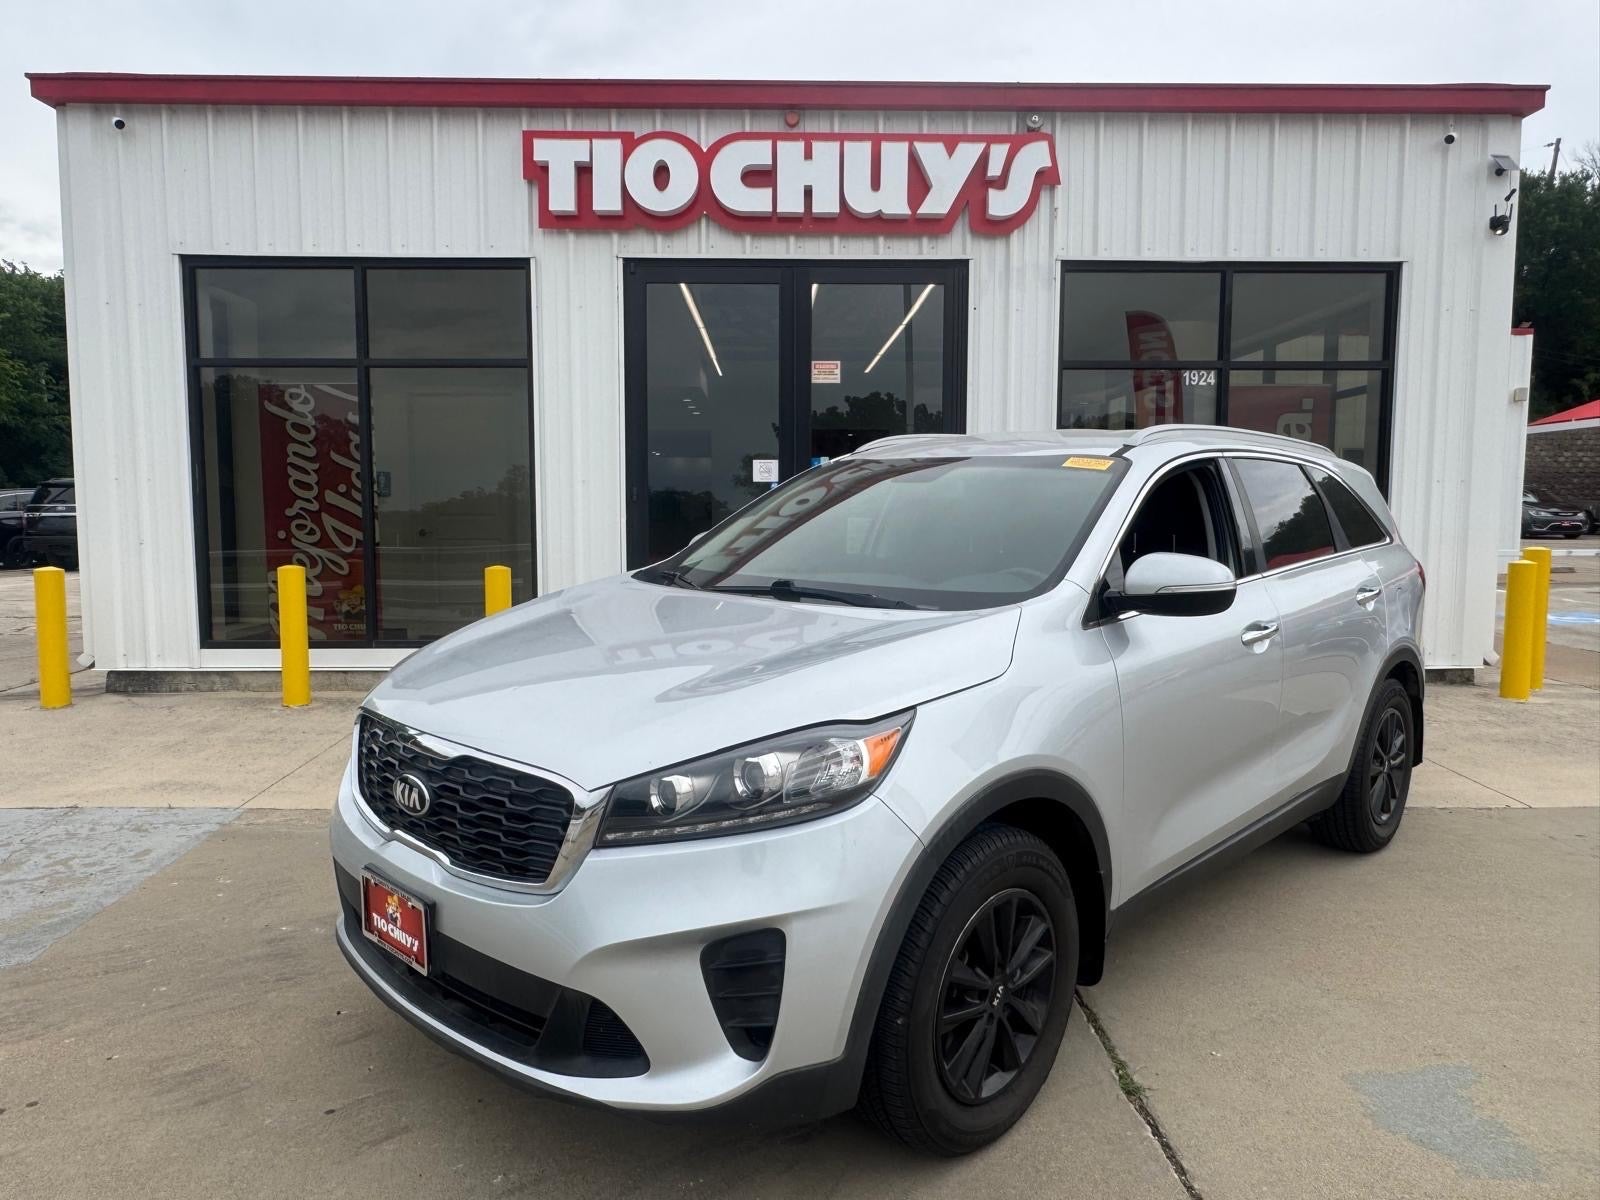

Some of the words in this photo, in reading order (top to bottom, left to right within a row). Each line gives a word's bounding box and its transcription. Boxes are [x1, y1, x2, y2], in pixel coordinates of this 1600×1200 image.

[532, 137, 700, 218] TIO
[709, 138, 1053, 221] CHUY'S
[1183, 370, 1216, 386] 1924
[396, 780, 421, 811] KIA
[372, 912, 388, 932] TIO
[388, 923, 419, 952] CHUY'S
